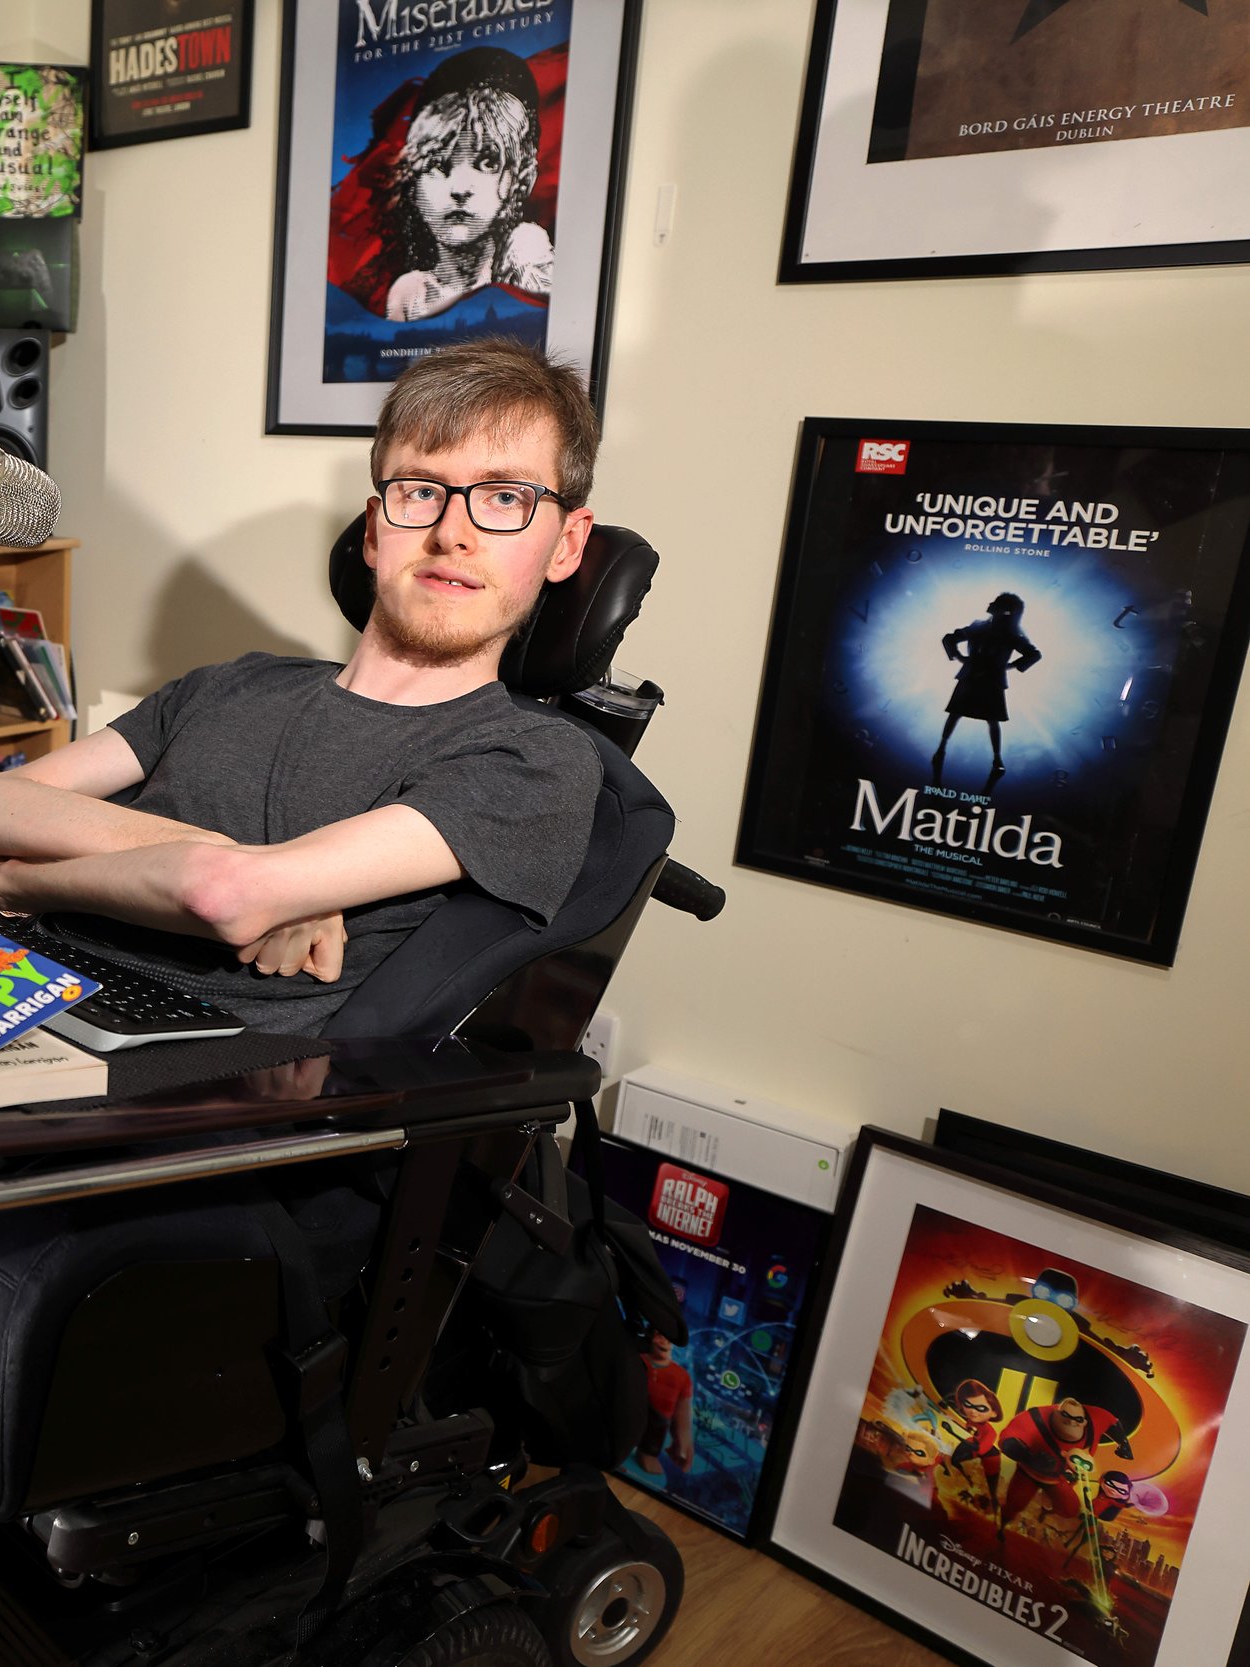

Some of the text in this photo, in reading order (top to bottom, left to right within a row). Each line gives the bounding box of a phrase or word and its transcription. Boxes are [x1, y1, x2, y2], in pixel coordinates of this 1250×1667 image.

[354, 47, 384, 63] FOR
[391, 38, 421, 56] THE
[428, 30, 465, 48] 21ST
[472, 11, 554, 39] CENTURY
[109, 25, 232, 86] HADESTOWN
[0, 109, 23, 123] am
[958, 93, 1236, 137] BORD GÁIS ENERGY THEATRE
[1055, 125, 1114, 142] DUBLIN
[380, 347, 432, 358] SONDHEIM
[862, 442, 906, 462] RSC
[1045, 500, 1120, 525] AND
[964, 543, 1050, 557] ROLLING STONE
[924, 785, 957, 799] ROALD
[849, 778, 1064, 869] Matilda
[914, 844, 983, 867] THE MUSICAL
[663, 1178, 718, 1213] RALPH
[656, 1202, 713, 1238] INTERNET
[670, 1239, 730, 1268] NOVEMBER
[731, 1263, 746, 1274] 30
[939, 1533, 1034, 1593] Disney PIXAR
[896, 1522, 1069, 1643] INCREDIBLES 2
